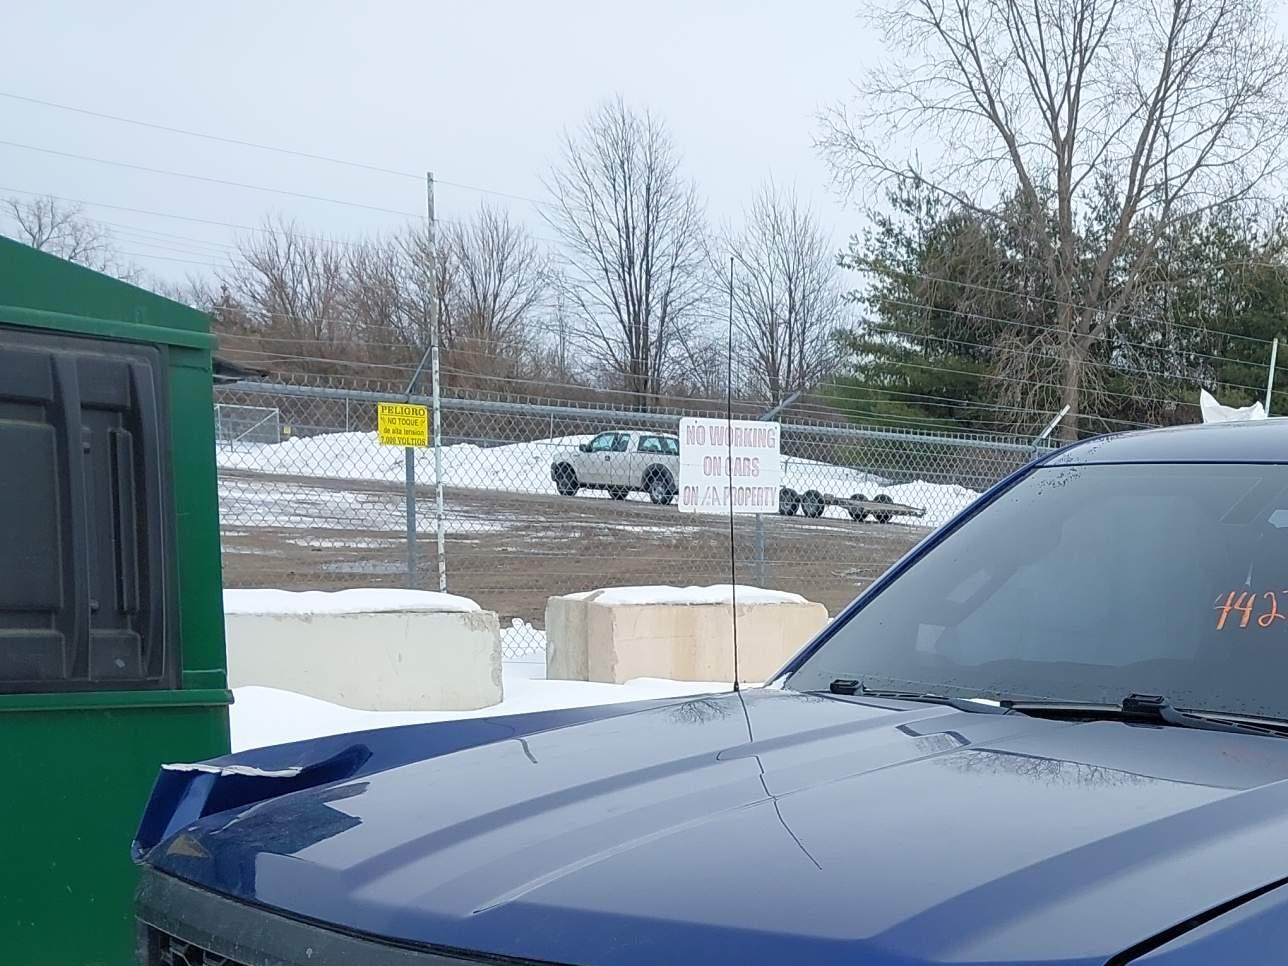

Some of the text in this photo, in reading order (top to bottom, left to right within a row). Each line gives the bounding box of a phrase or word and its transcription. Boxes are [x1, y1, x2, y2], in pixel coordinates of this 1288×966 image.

[382, 406, 425, 416] PELIGRO
[387, 417, 419, 426] NO TOQUE
[686, 425, 776, 448] NO WORKING
[703, 456, 760, 477] ON CARS
[683, 485, 699, 506] ON
[723, 486, 777, 507] PROPERTY
